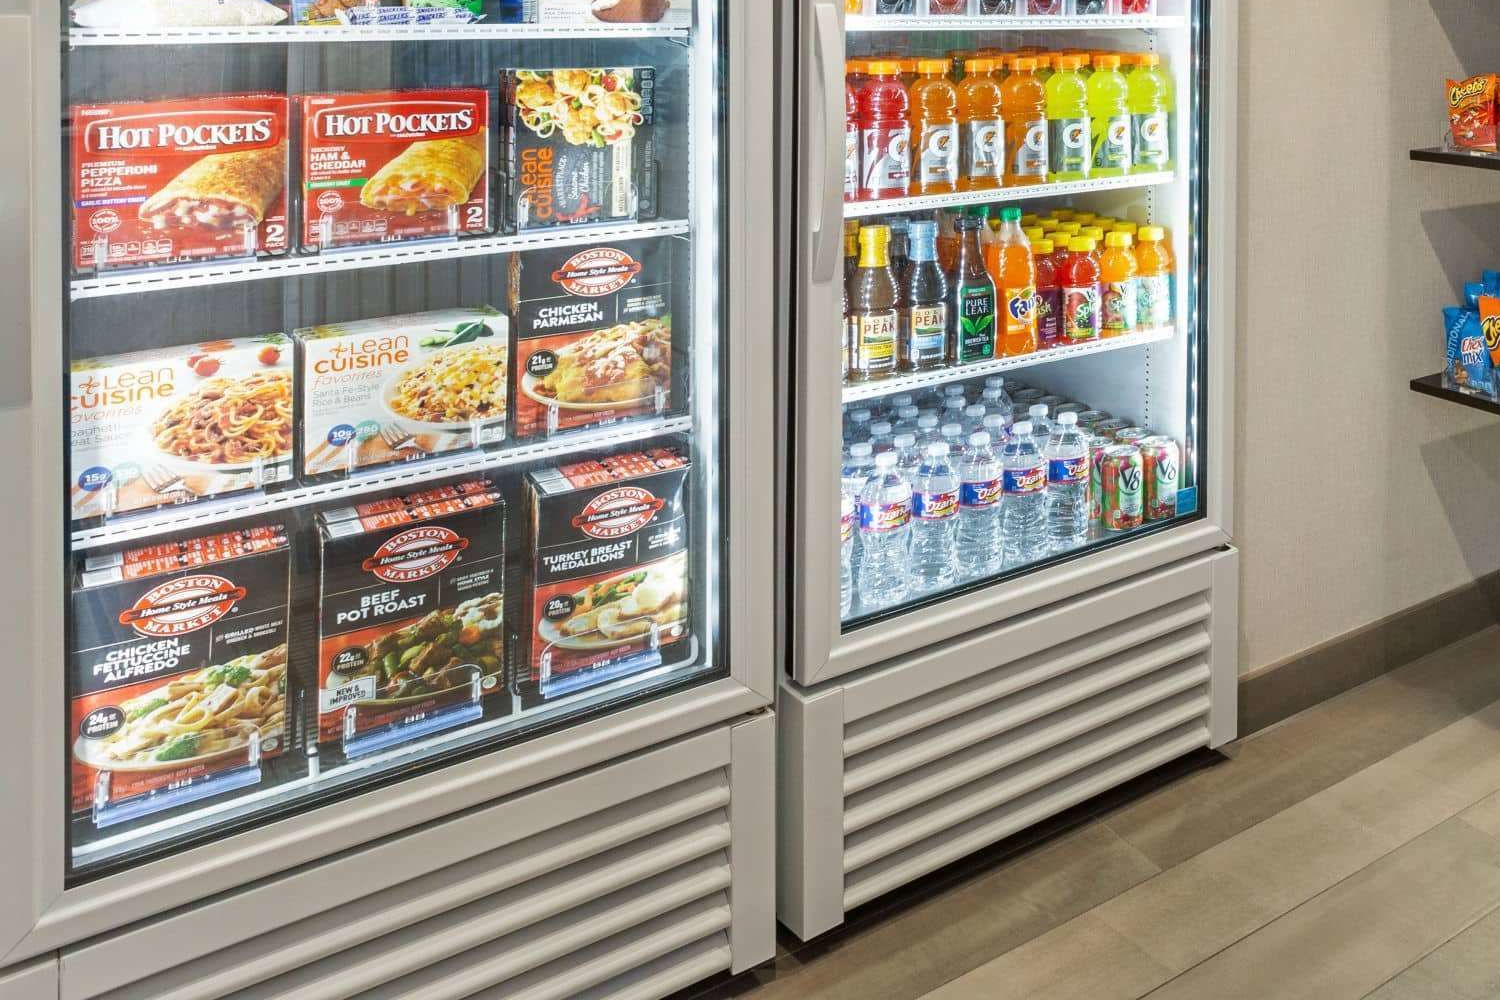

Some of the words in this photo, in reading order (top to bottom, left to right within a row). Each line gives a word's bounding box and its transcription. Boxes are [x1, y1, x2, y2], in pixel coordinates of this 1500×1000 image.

[325, 114, 372, 136] HOT
[375, 109, 472, 134] POCKETS
[98, 125, 154, 150] HOT
[157, 119, 272, 148] POCKETS
[310, 159, 366, 171] CHEDDAR
[311, 152, 338, 162] HAM
[339, 152, 350, 160] &
[80, 165, 158, 178] PEPPERONI
[81, 177, 122, 188] PIZZA
[467, 206, 483, 223] 2
[266, 224, 284, 243] 2
[572, 250, 625, 266] BOSTON
[569, 278, 625, 293] MARKET
[538, 302, 598, 318] CHICKEN
[966, 298, 988, 306] PURE
[966, 306, 988, 316] LEAF
[533, 311, 603, 330] PARMESAN
[1161, 456, 1176, 479] V8
[1119, 464, 1140, 491] V8
[591, 488, 646, 510] BOSTON
[590, 516, 646, 536] MARKET
[386, 528, 449, 551] BOSTON
[380, 553, 404, 565] Home
[406, 549, 427, 561] Style
[543, 548, 588, 565] TURKEY
[591, 540, 633, 557] BREAST
[550, 551, 625, 573] MEDALLIONS
[383, 554, 448, 581] MARKET
[148, 577, 224, 602] BOSTON
[140, 604, 171, 618] Home
[172, 599, 198, 611] Style
[336, 607, 371, 624] POT
[373, 594, 427, 617] ROAST
[360, 590, 401, 609] BEEF
[144, 607, 224, 634] MARKET
[106, 638, 179, 662] CHICKEN
[93, 644, 191, 676] FETTUCCINE
[103, 657, 179, 684] ALFREDO
[329, 691, 367, 705] IMPROVED
[336, 687, 353, 697] NEW
